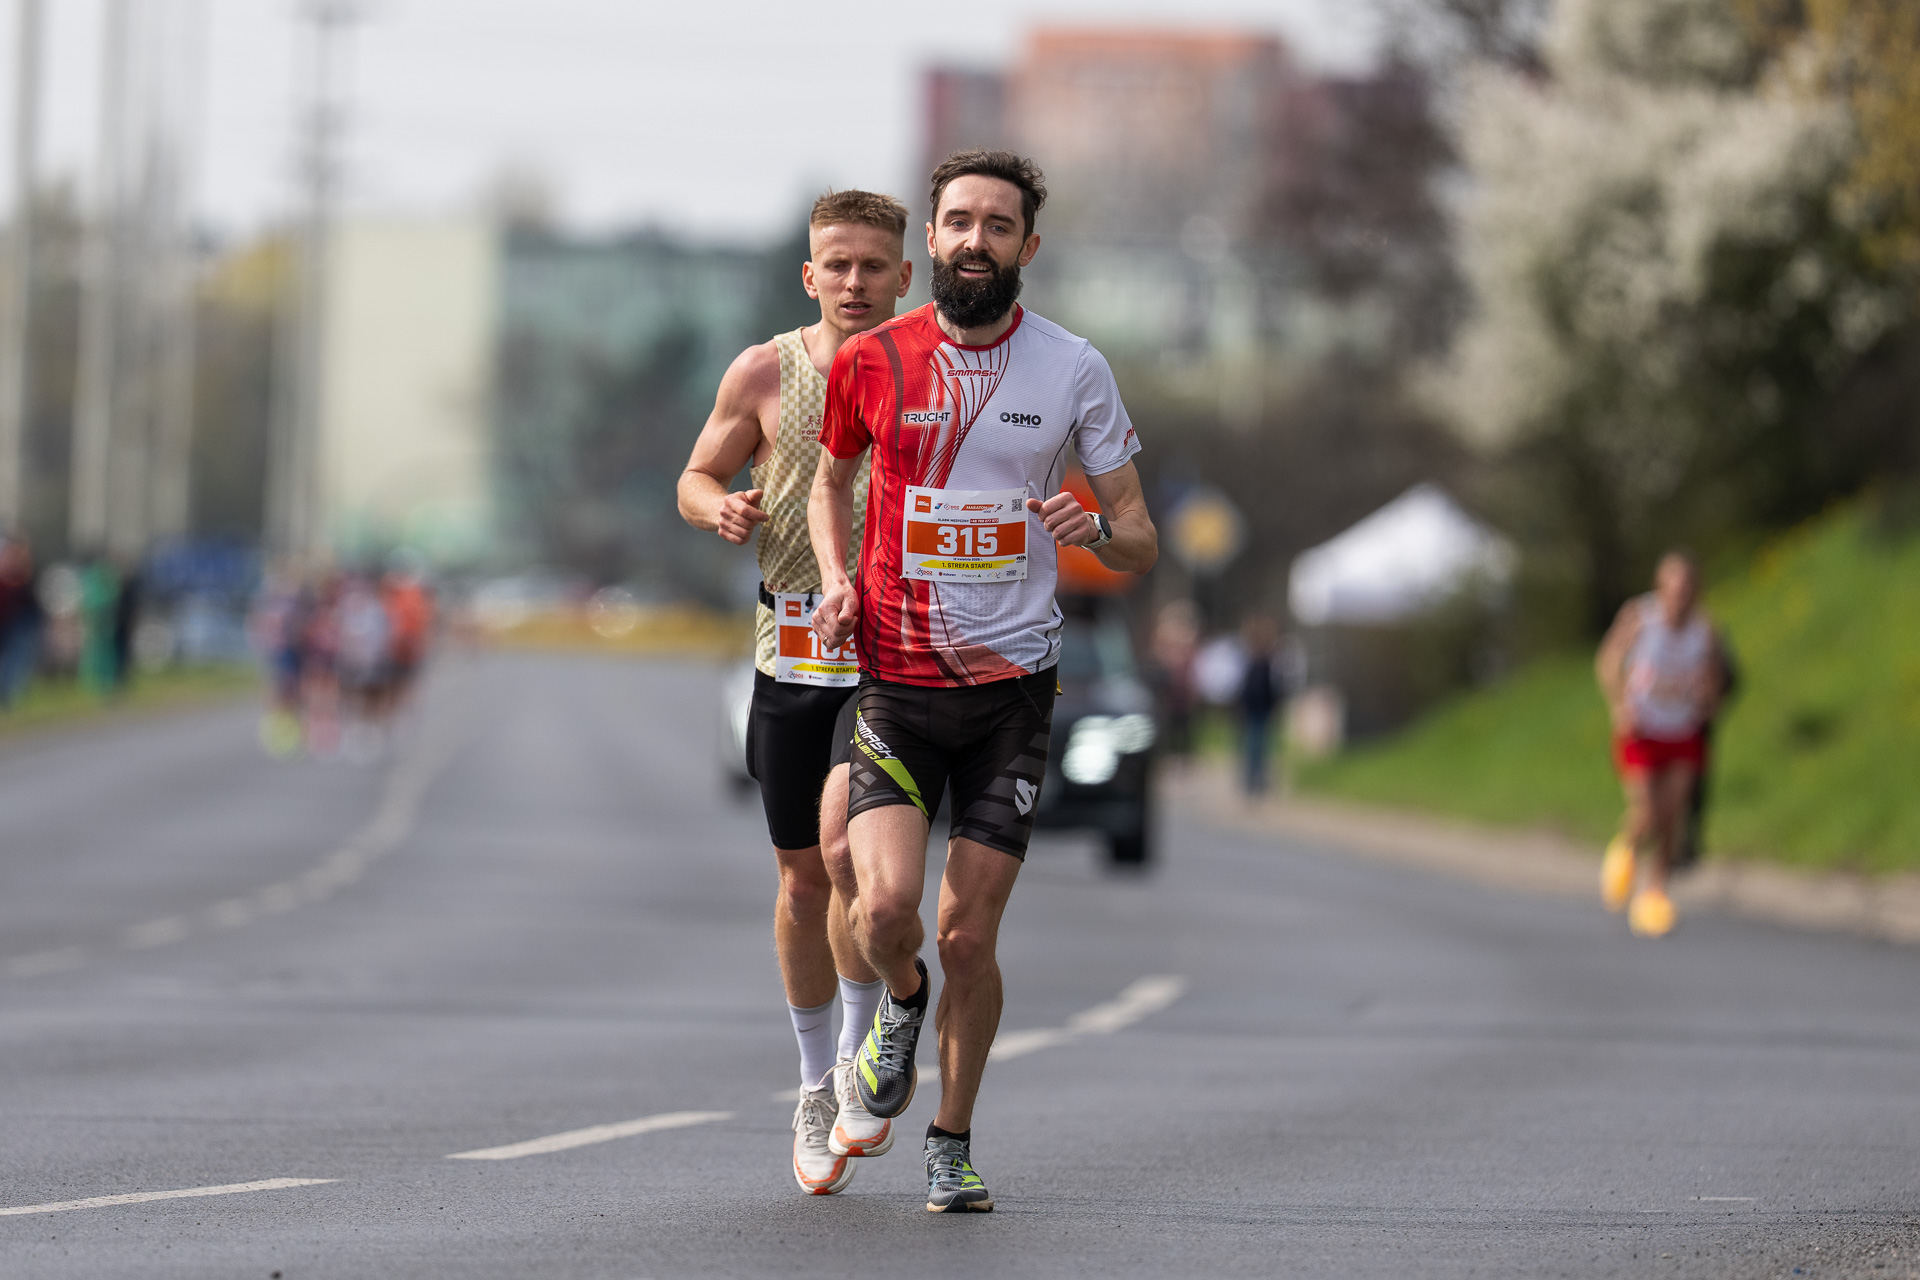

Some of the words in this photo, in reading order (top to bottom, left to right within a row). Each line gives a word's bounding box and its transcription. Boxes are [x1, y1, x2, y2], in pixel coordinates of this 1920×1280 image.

[947, 369, 998, 377] SMMASH
[903, 412, 951, 423] TRUCHT
[999, 412, 1042, 426] OSMO
[937, 526, 998, 555] 315
[857, 716, 898, 760] SMMASH
